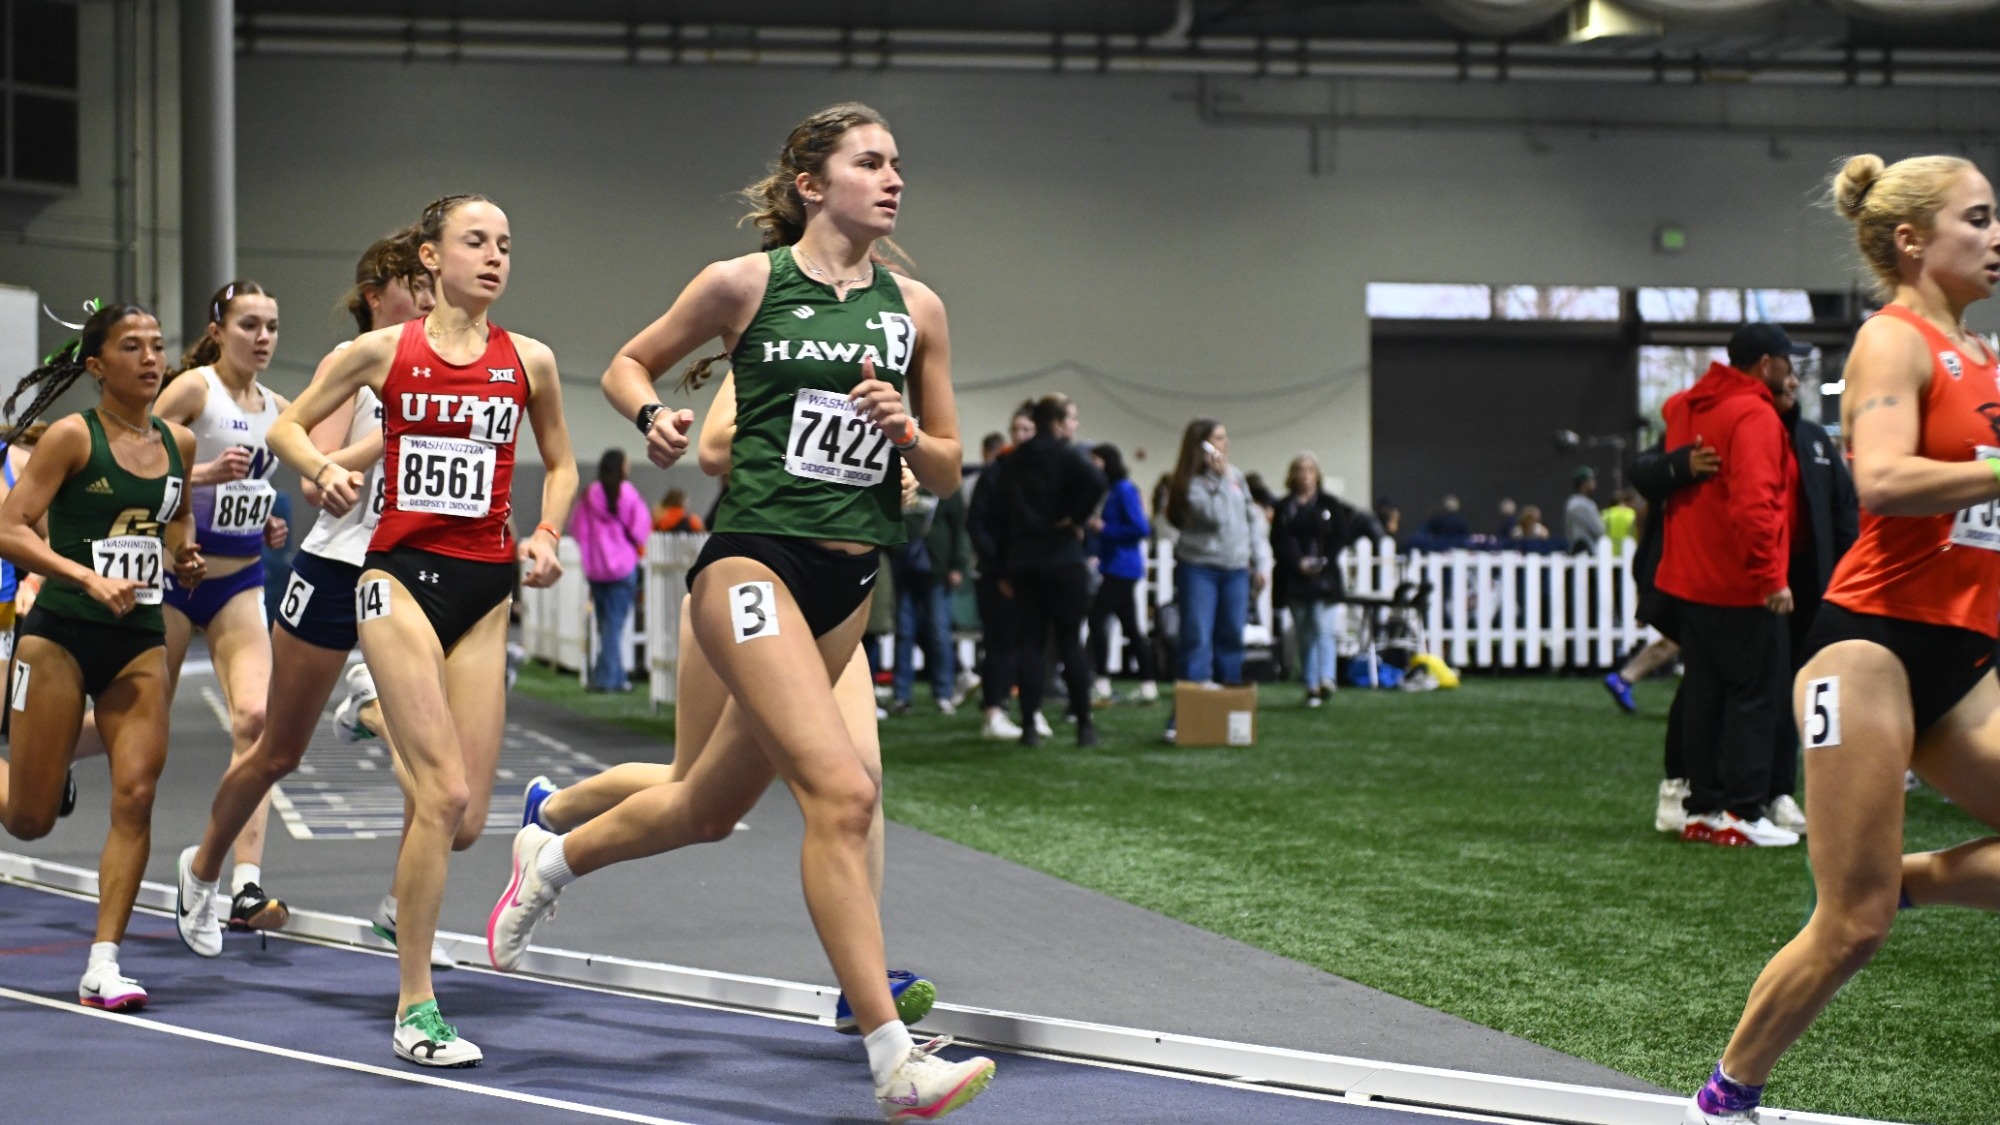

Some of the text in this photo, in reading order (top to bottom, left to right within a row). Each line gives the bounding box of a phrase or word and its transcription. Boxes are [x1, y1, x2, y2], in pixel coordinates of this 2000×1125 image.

[890, 315, 910, 367] 3
[401, 393, 514, 423] UTA
[483, 405, 513, 441] 14
[410, 439, 486, 455] WASHINGTON
[794, 410, 888, 471] 7422
[404, 453, 485, 501] 8561
[800, 462, 842, 477] DEMPSEY
[164, 481, 180, 520] 7
[217, 495, 272, 527] 8641
[409, 498, 480, 512] DEMPSEY INDOOR
[102, 540, 157, 549] WASHINGTON
[98, 552, 160, 590] 7112
[285, 581, 306, 619] 6
[359, 582, 383, 620] 14
[738, 584, 767, 637] 3
[12, 664, 25, 705] 7
[1812, 682, 1830, 745] 5
